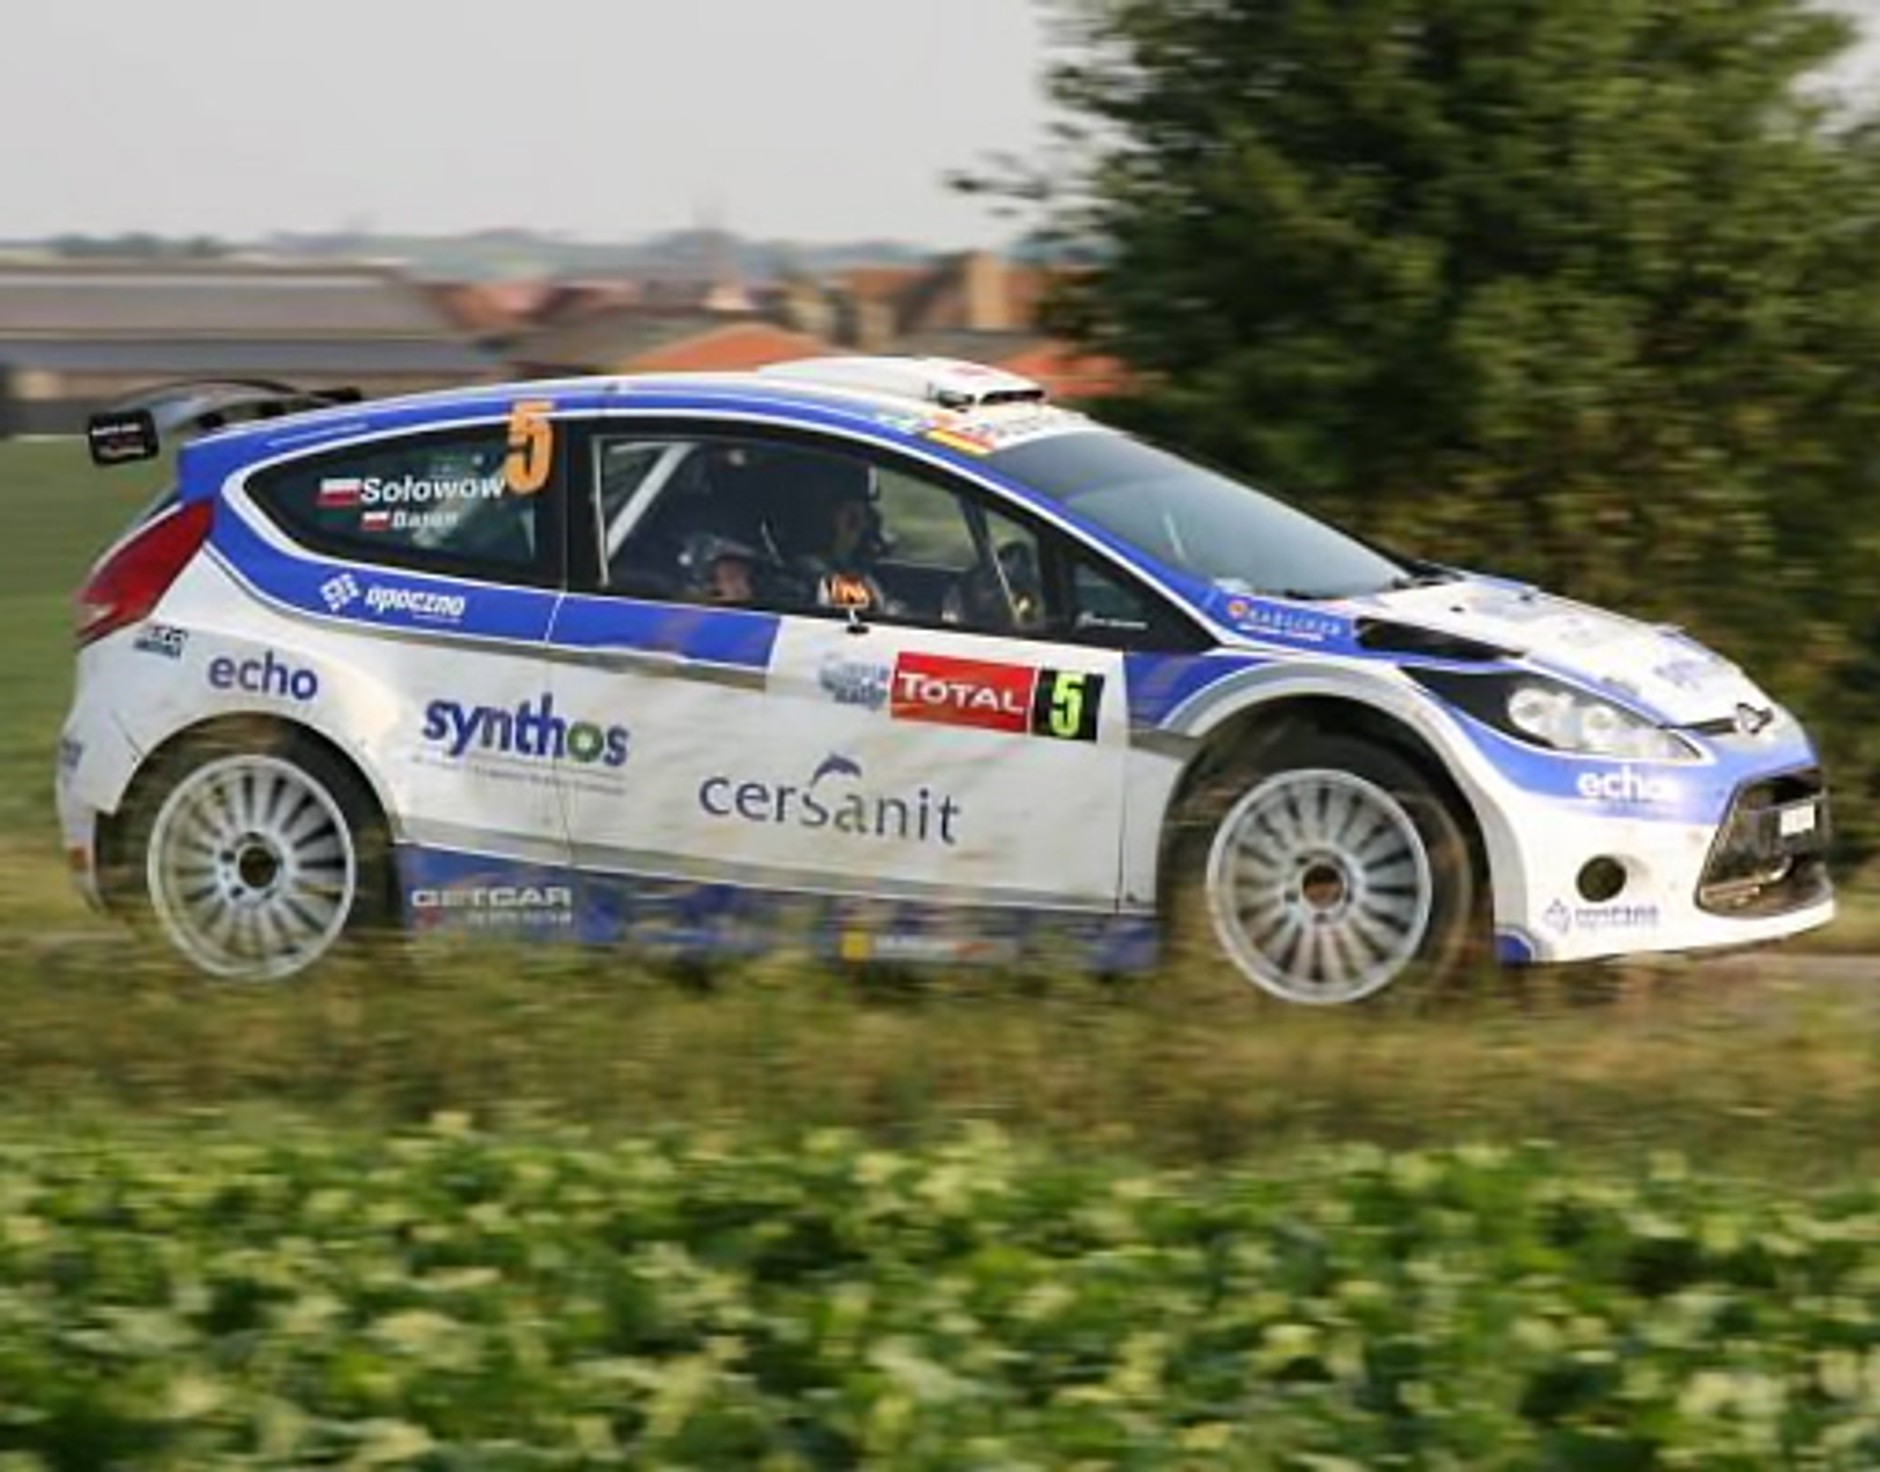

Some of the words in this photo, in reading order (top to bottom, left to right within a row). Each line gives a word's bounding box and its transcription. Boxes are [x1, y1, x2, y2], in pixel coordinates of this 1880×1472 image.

[505, 400, 556, 494] 5
[365, 586, 466, 617] opoczno
[208, 649, 319, 701] echo
[897, 672, 1026, 714] TOTAL
[1050, 670, 1084, 738] 5
[421, 691, 630, 768] synthos
[699, 772, 962, 844] cersanit
